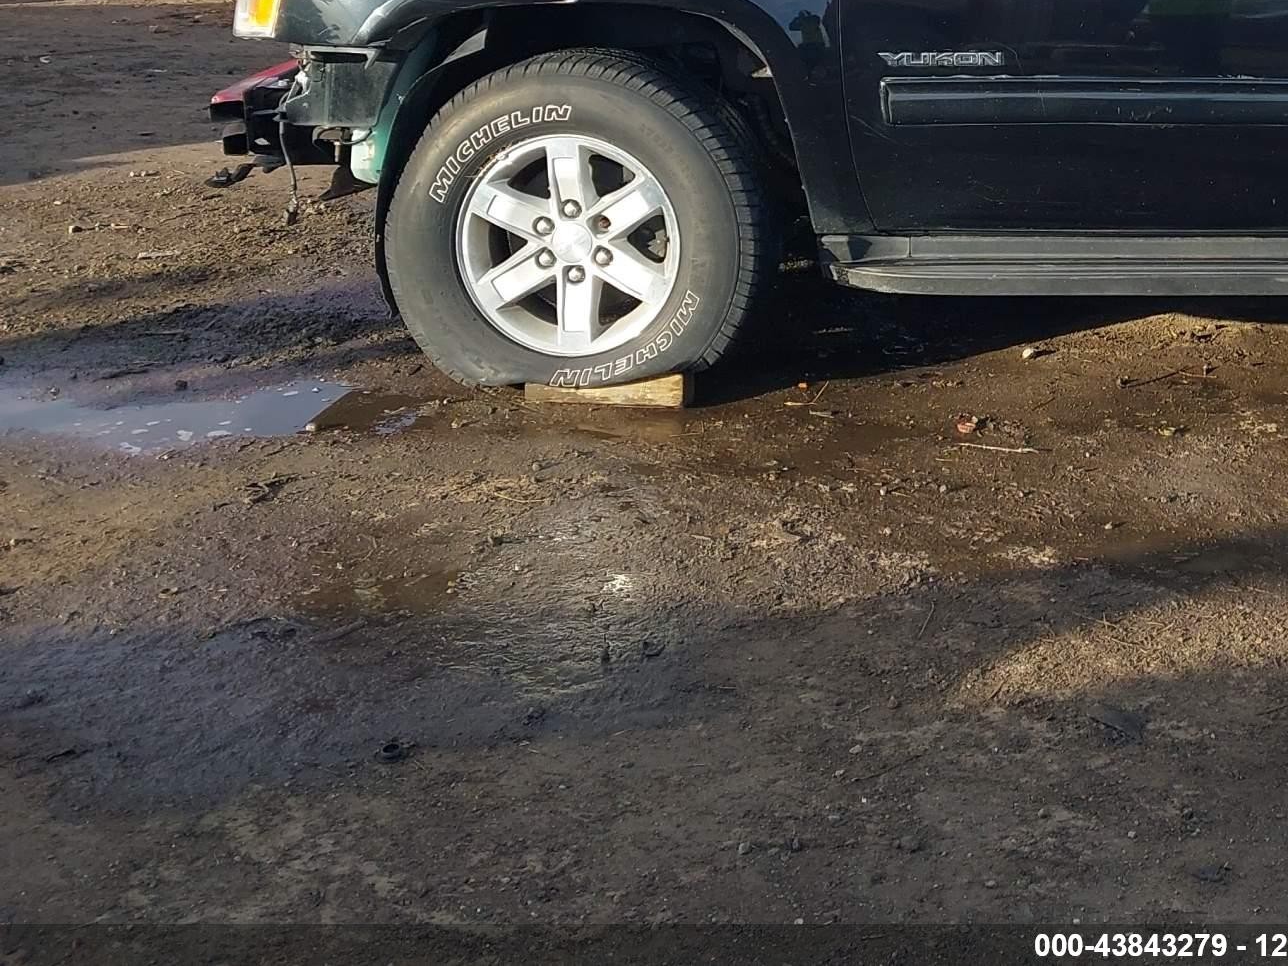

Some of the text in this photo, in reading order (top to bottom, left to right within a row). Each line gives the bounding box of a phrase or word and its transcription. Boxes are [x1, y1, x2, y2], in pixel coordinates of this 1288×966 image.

[877, 52, 1004, 66] YUKON
[429, 104, 573, 203] MICHELIN
[549, 289, 700, 387] MICHELIN
